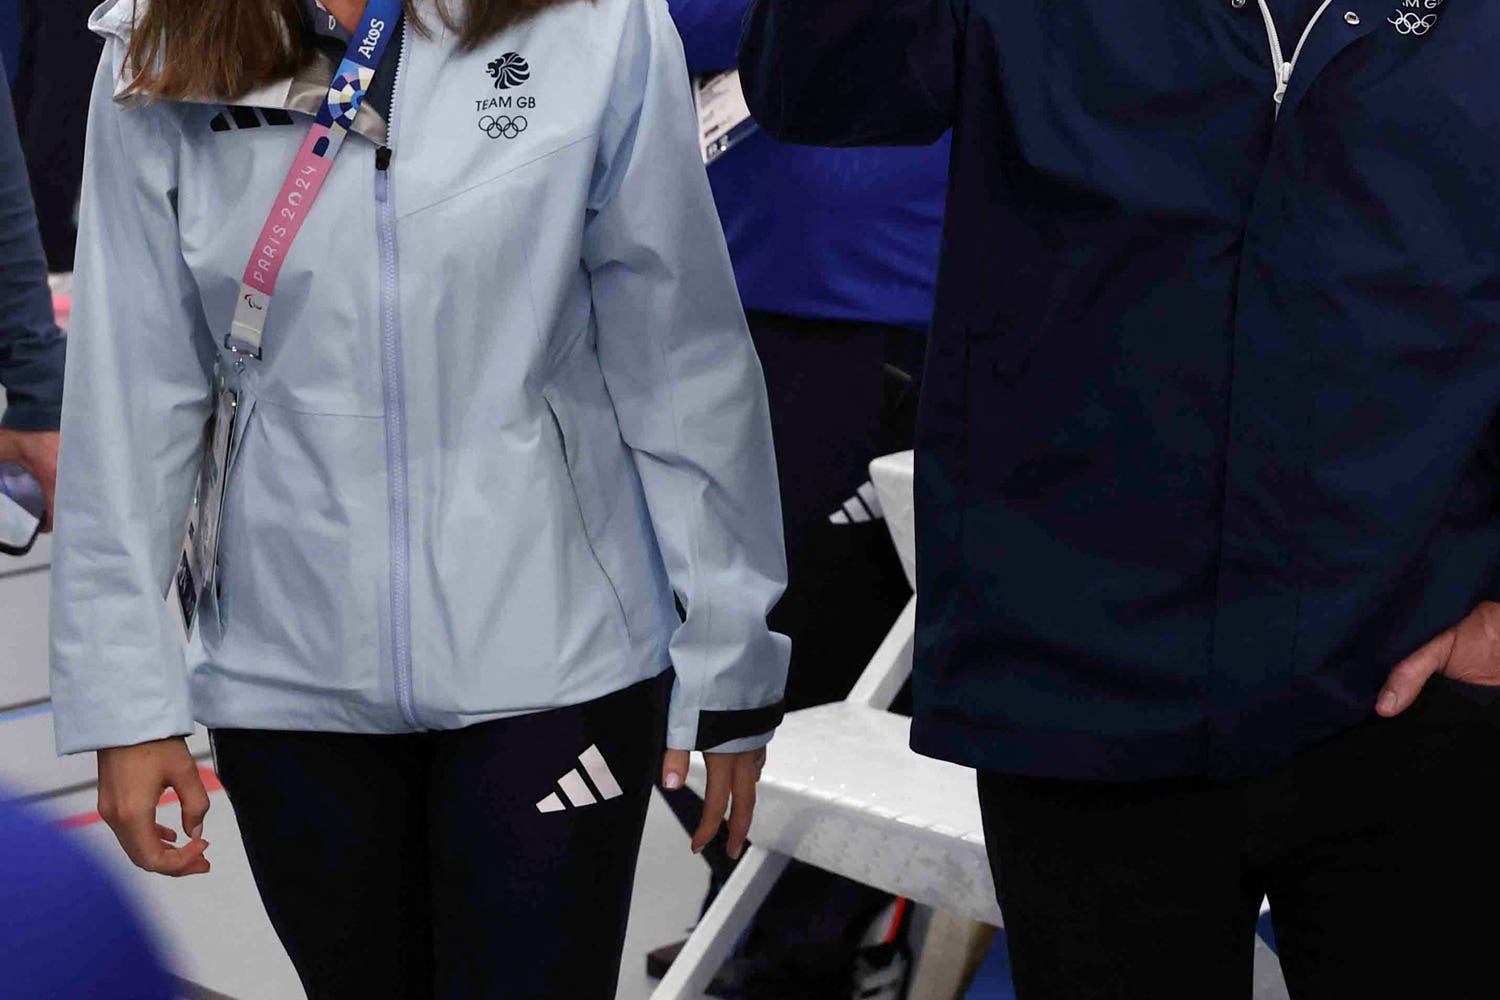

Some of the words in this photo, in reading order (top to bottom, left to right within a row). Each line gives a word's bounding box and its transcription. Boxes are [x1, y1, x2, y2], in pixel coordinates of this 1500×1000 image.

[358, 18, 385, 59] Atos
[475, 96, 512, 112] TEAM
[516, 96, 536, 109] GB
[253, 225, 286, 283] PARIS
[281, 165, 317, 221] 2024
